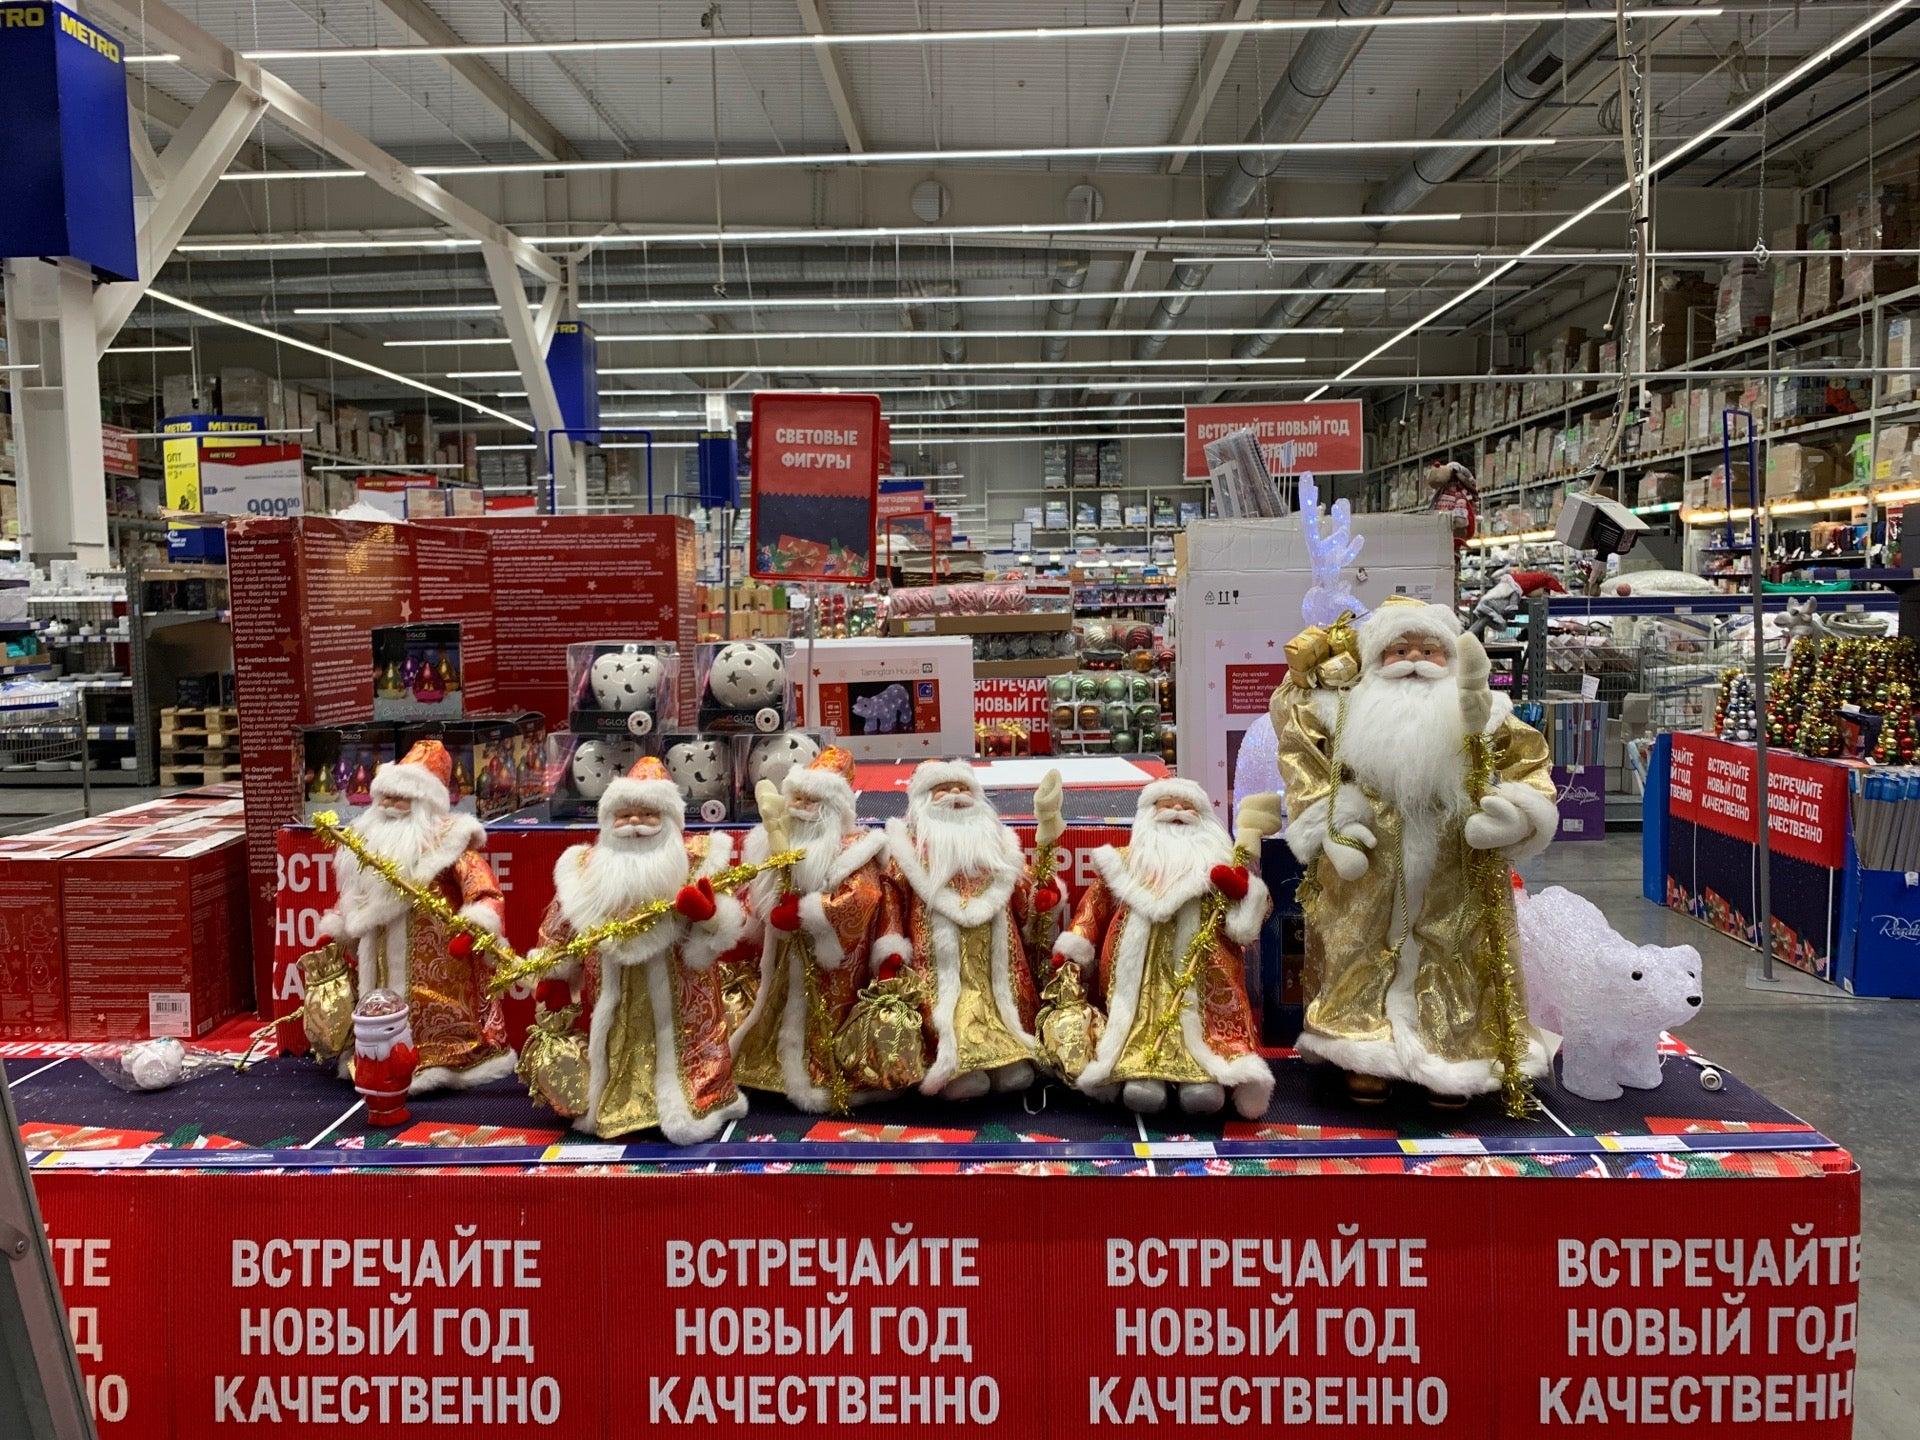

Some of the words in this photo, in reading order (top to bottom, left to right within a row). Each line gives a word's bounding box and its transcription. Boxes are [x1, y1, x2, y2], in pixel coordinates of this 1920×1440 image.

[60, 11, 120, 64] METRO
[208, 422, 258, 431] METRO
[775, 428, 858, 447] СВЕТОВЫЕ
[1277, 416, 1320, 436] НОВЫЙ
[1324, 419, 1350, 436] ГОД
[781, 452, 851, 470] ФИГУРЫ
[860, 668, 895, 677] Tarrington
[975, 693, 1028, 712] НОВЫЙ
[1678, 768, 1691, 785] ГОД
[1707, 757, 1750, 782] ВСТРЕЧАЙТЕ
[1707, 776, 1731, 795] НОВЫЙ
[1732, 784, 1746, 802] ГОД
[1768, 773, 1823, 800] ВСТРЕЧАЙТЕ
[1702, 794, 1750, 821] КАЧЕСТВЕННО
[1767, 793, 1799, 815] НОВЫЙ
[1801, 801, 1819, 823] ГОД
[231, 1224, 542, 1288] ВСТРЕЧАЙТЕ
[666, 1222, 981, 1288] ВСТРЕЧАЙТЕ
[1107, 1223, 1428, 1288] ВСТРЕЧАЙТЕ
[240, 1292, 418, 1356] НОВЫЙ
[434, 1307, 535, 1364] ГОД
[674, 1291, 853, 1356] НОВЫЙ
[871, 1307, 974, 1364] ГОД
[1115, 1292, 1299, 1357] НОВЫЙ
[1316, 1307, 1421, 1364] ГОД
[1567, 1292, 1751, 1357] НОВЫЙ
[1768, 1306, 1857, 1361] ГОД
[214, 1375, 561, 1424] КАЧЕСТВЕННО
[649, 1375, 1000, 1424] КАЧЕСТВЕННО
[1089, 1376, 1448, 1425] КАЧЕСТВЕННО
